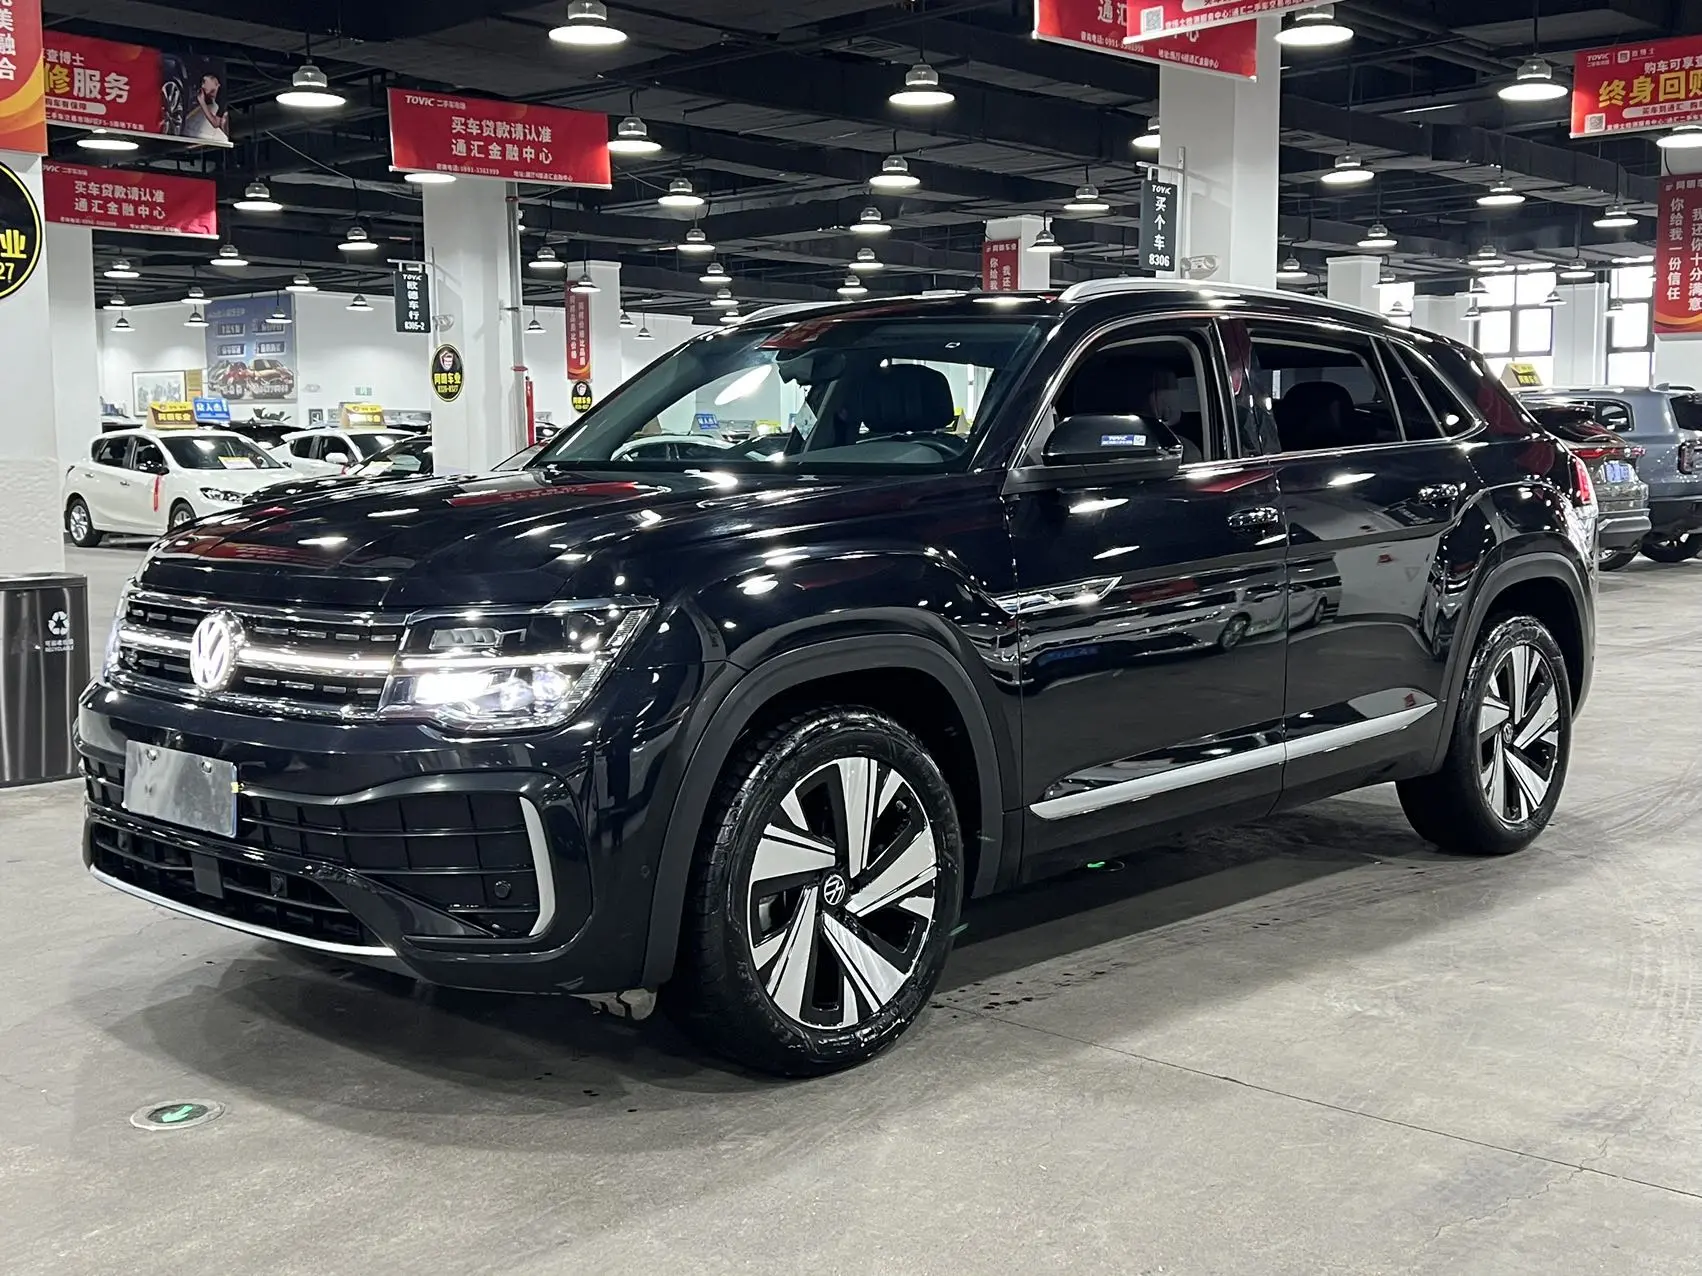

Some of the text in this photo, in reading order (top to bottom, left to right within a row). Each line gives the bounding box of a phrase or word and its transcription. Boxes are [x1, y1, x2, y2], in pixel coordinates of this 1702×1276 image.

[405, 94, 435, 107] TOVIC
[451, 116, 552, 143] 买车贷款请认准
[451, 138, 553, 165] 通汇金融中心
[74, 180, 165, 203] 买车贷款请认准
[74, 198, 166, 220] 通汇金融中心
[1153, 196, 1167, 251] 买个车
[1148, 253, 1170, 267] 8306
[1667, 198, 1685, 301] 你给我一份信任
